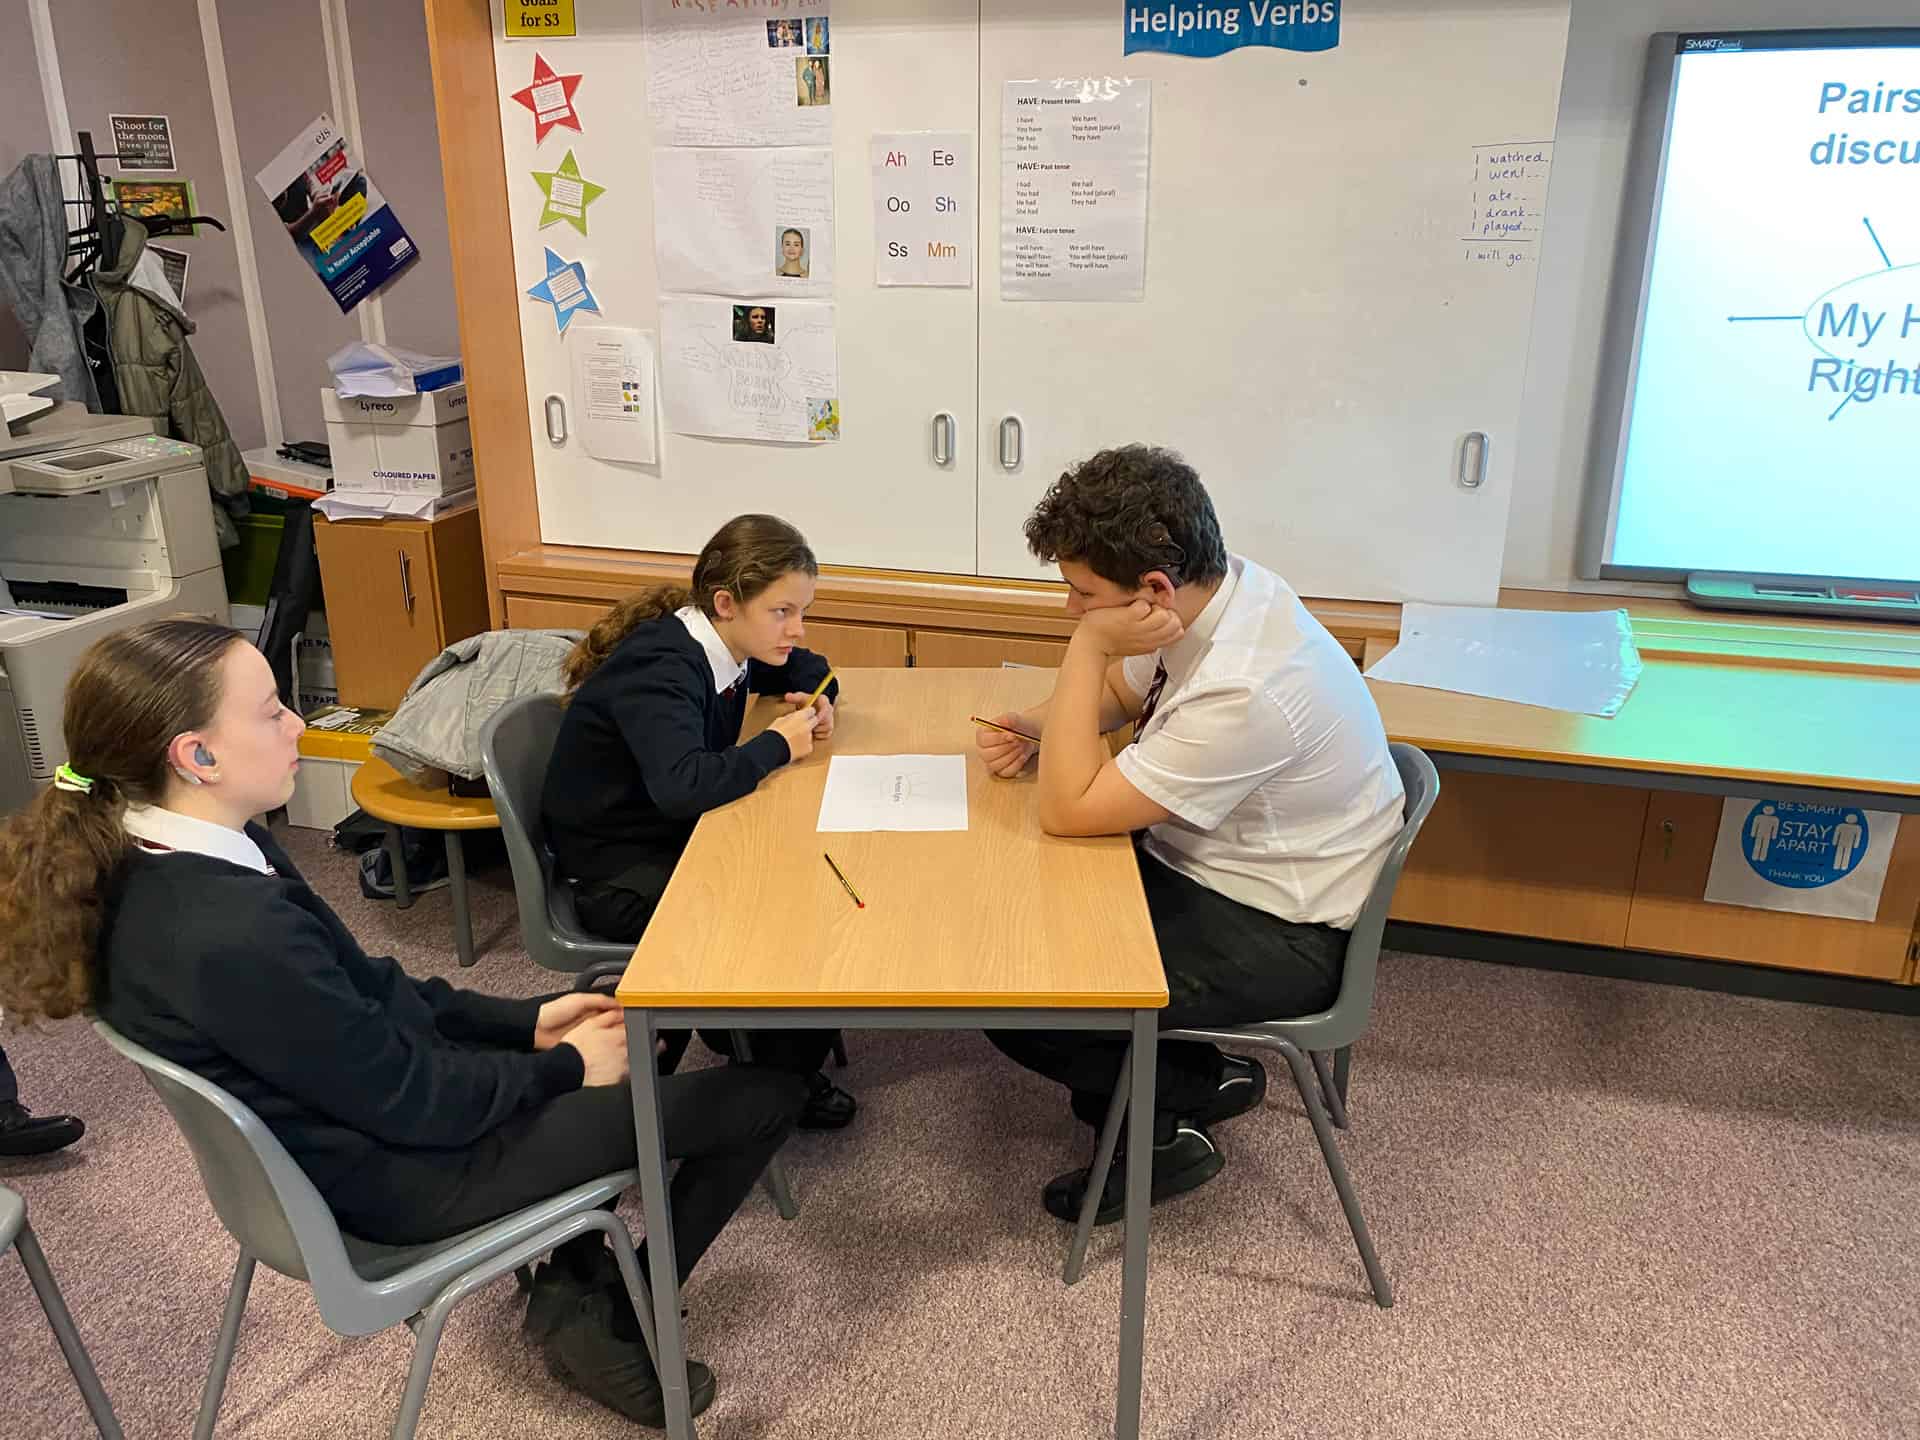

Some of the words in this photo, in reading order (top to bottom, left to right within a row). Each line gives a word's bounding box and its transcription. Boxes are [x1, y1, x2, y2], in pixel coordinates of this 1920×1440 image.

[520, 12, 541, 27] for
[544, 13, 560, 27] S3
[1130, 4, 1241, 37] Helping
[1249, 0, 1335, 26] Verbs
[1818, 81, 1920, 114] Pairs
[114, 120, 146, 130] Shoot
[148, 121, 166, 130] for
[117, 131, 135, 140] the
[314, 127, 333, 146] eis
[885, 151, 907, 167] Ah
[932, 150, 955, 167] Ee
[887, 196, 911, 213] Oo
[935, 196, 957, 213] Sh
[349, 227, 381, 257] Acceptable
[888, 241, 909, 257] Ss
[927, 241, 957, 257] Mm
[1817, 302, 1888, 348] My
[360, 400, 394, 412] Lyreco
[373, 471, 412, 480] COLOURED
[413, 472, 436, 481] PAPER
[1777, 799, 1794, 811] BE
[1780, 820, 1833, 839] STAY
[1775, 838, 1830, 855] APART
[1767, 868, 1801, 881] THANK
[1804, 872, 1825, 884] YOU
